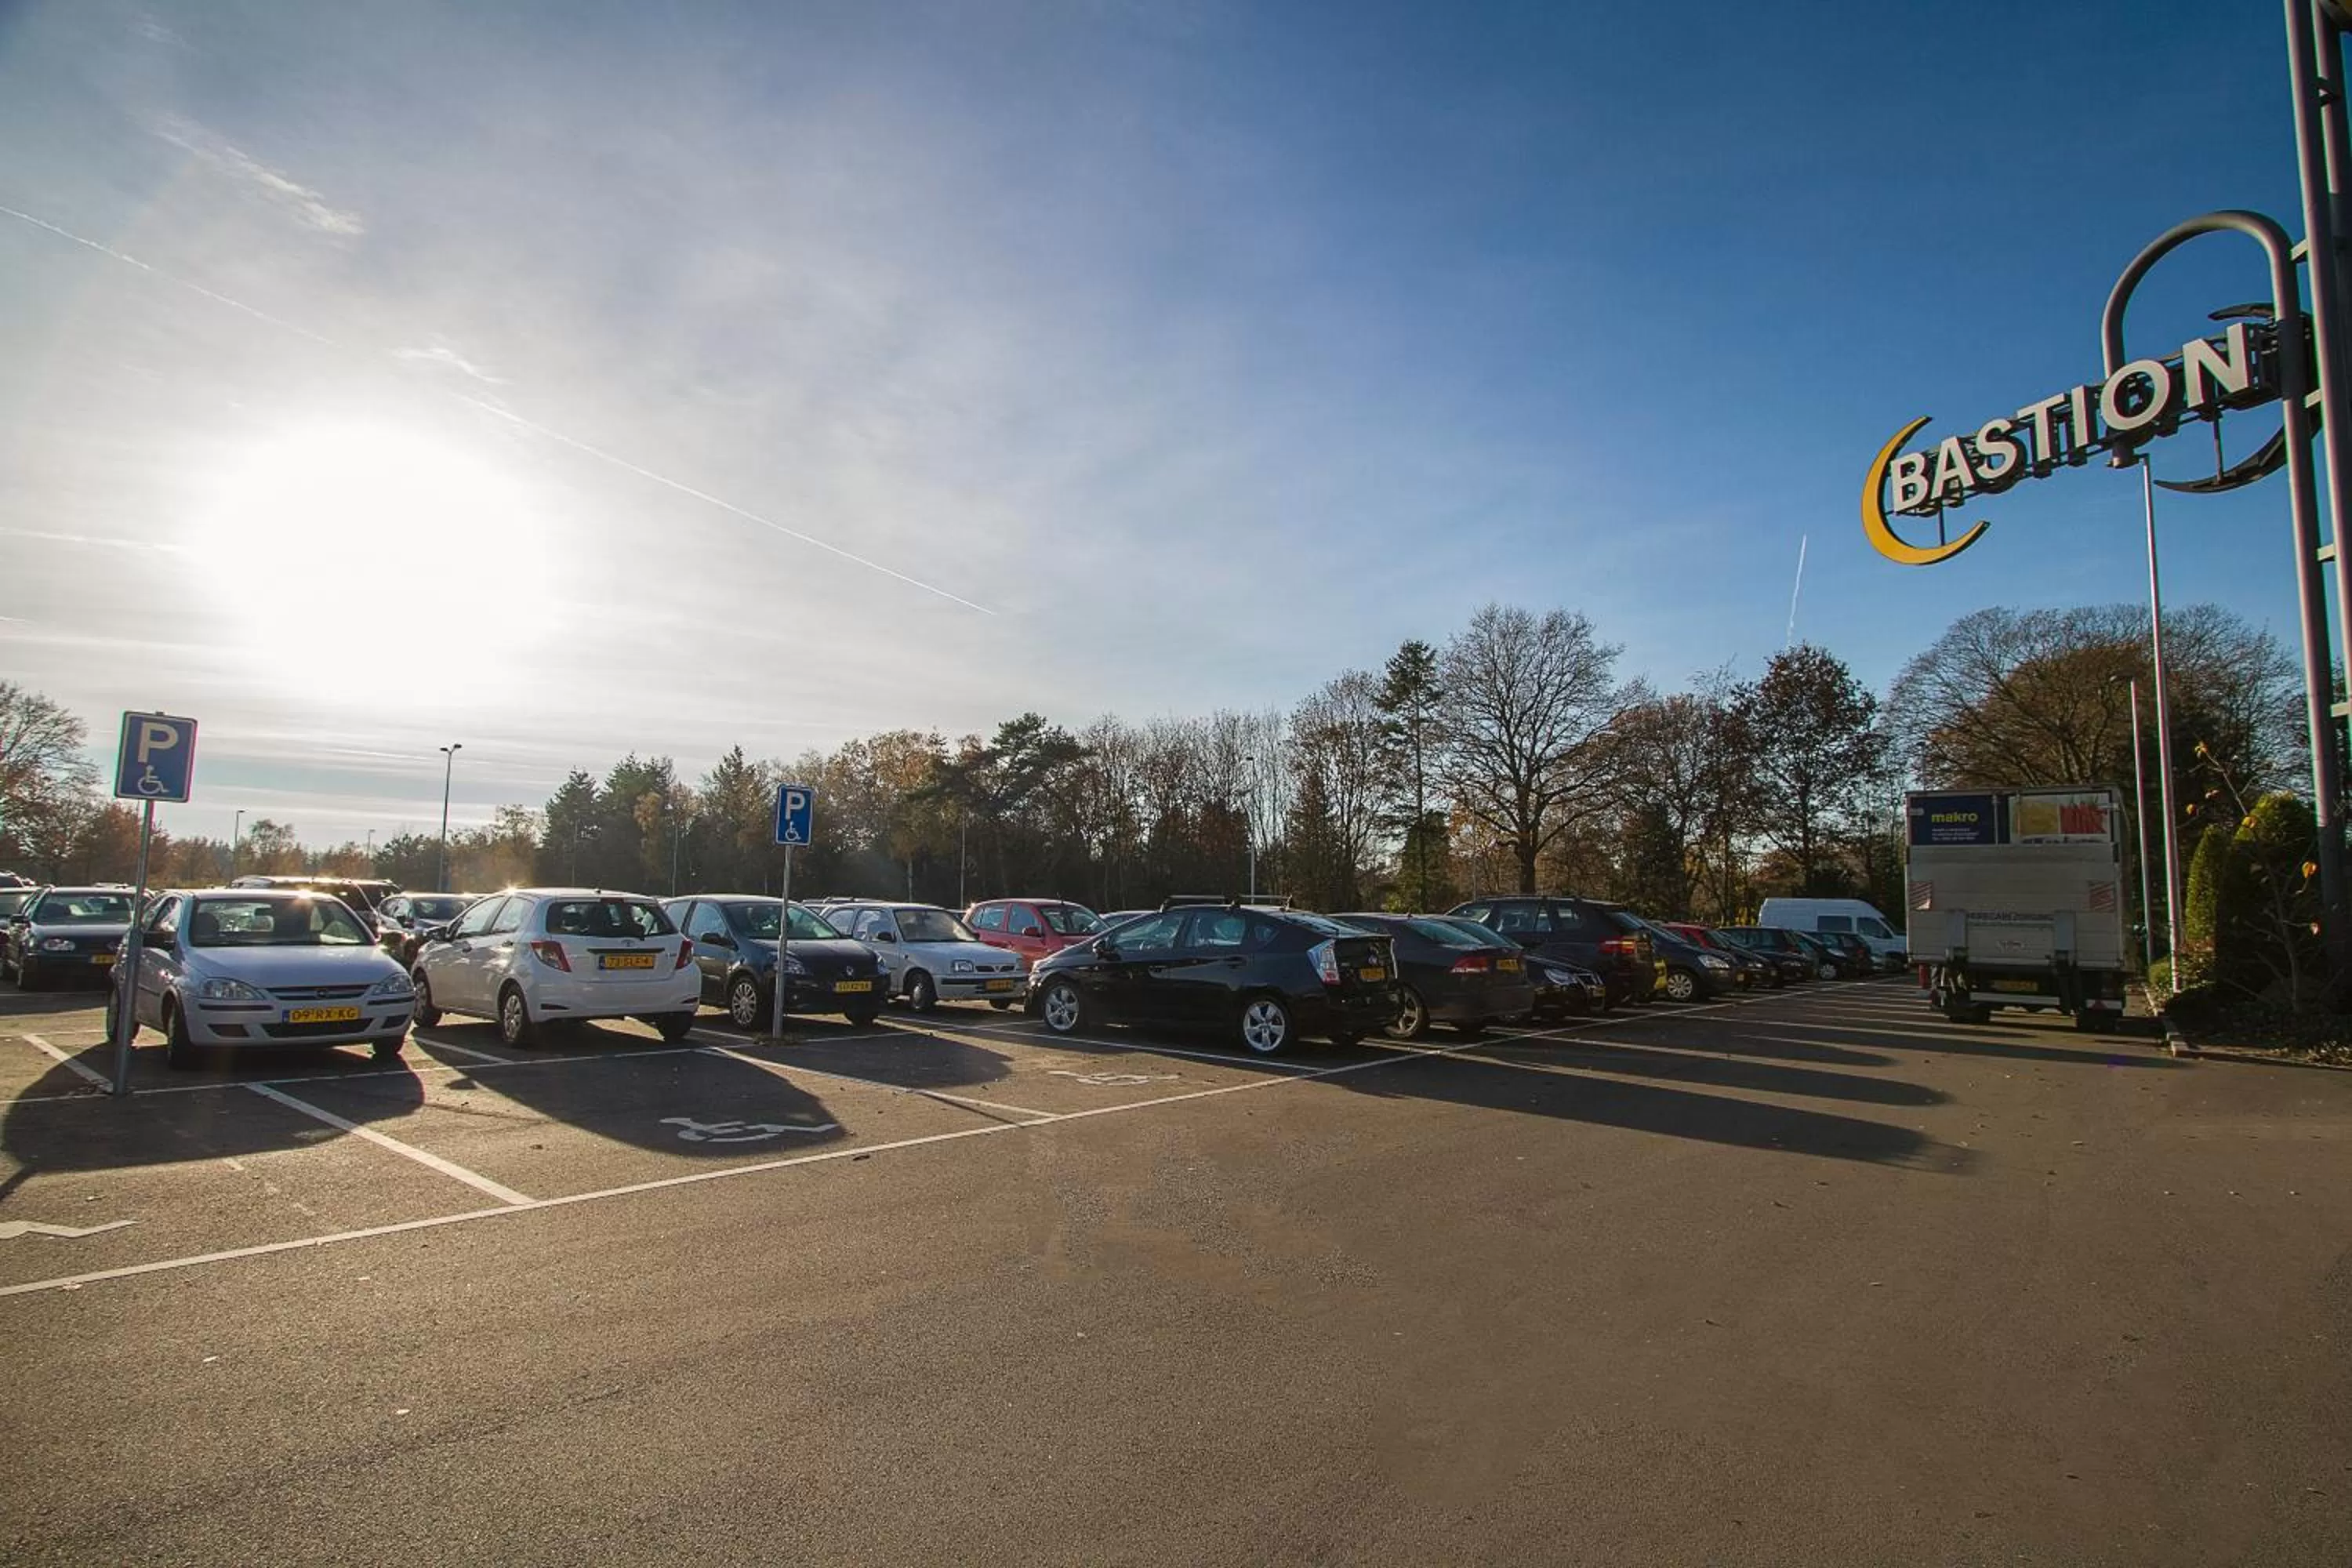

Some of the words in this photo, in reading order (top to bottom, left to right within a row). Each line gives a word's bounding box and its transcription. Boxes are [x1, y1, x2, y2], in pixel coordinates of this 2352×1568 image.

[1890, 322, 2251, 515] BASTION
[137, 721, 179, 763] P
[786, 790, 805, 820] P
[1931, 811, 1978, 822] makro
